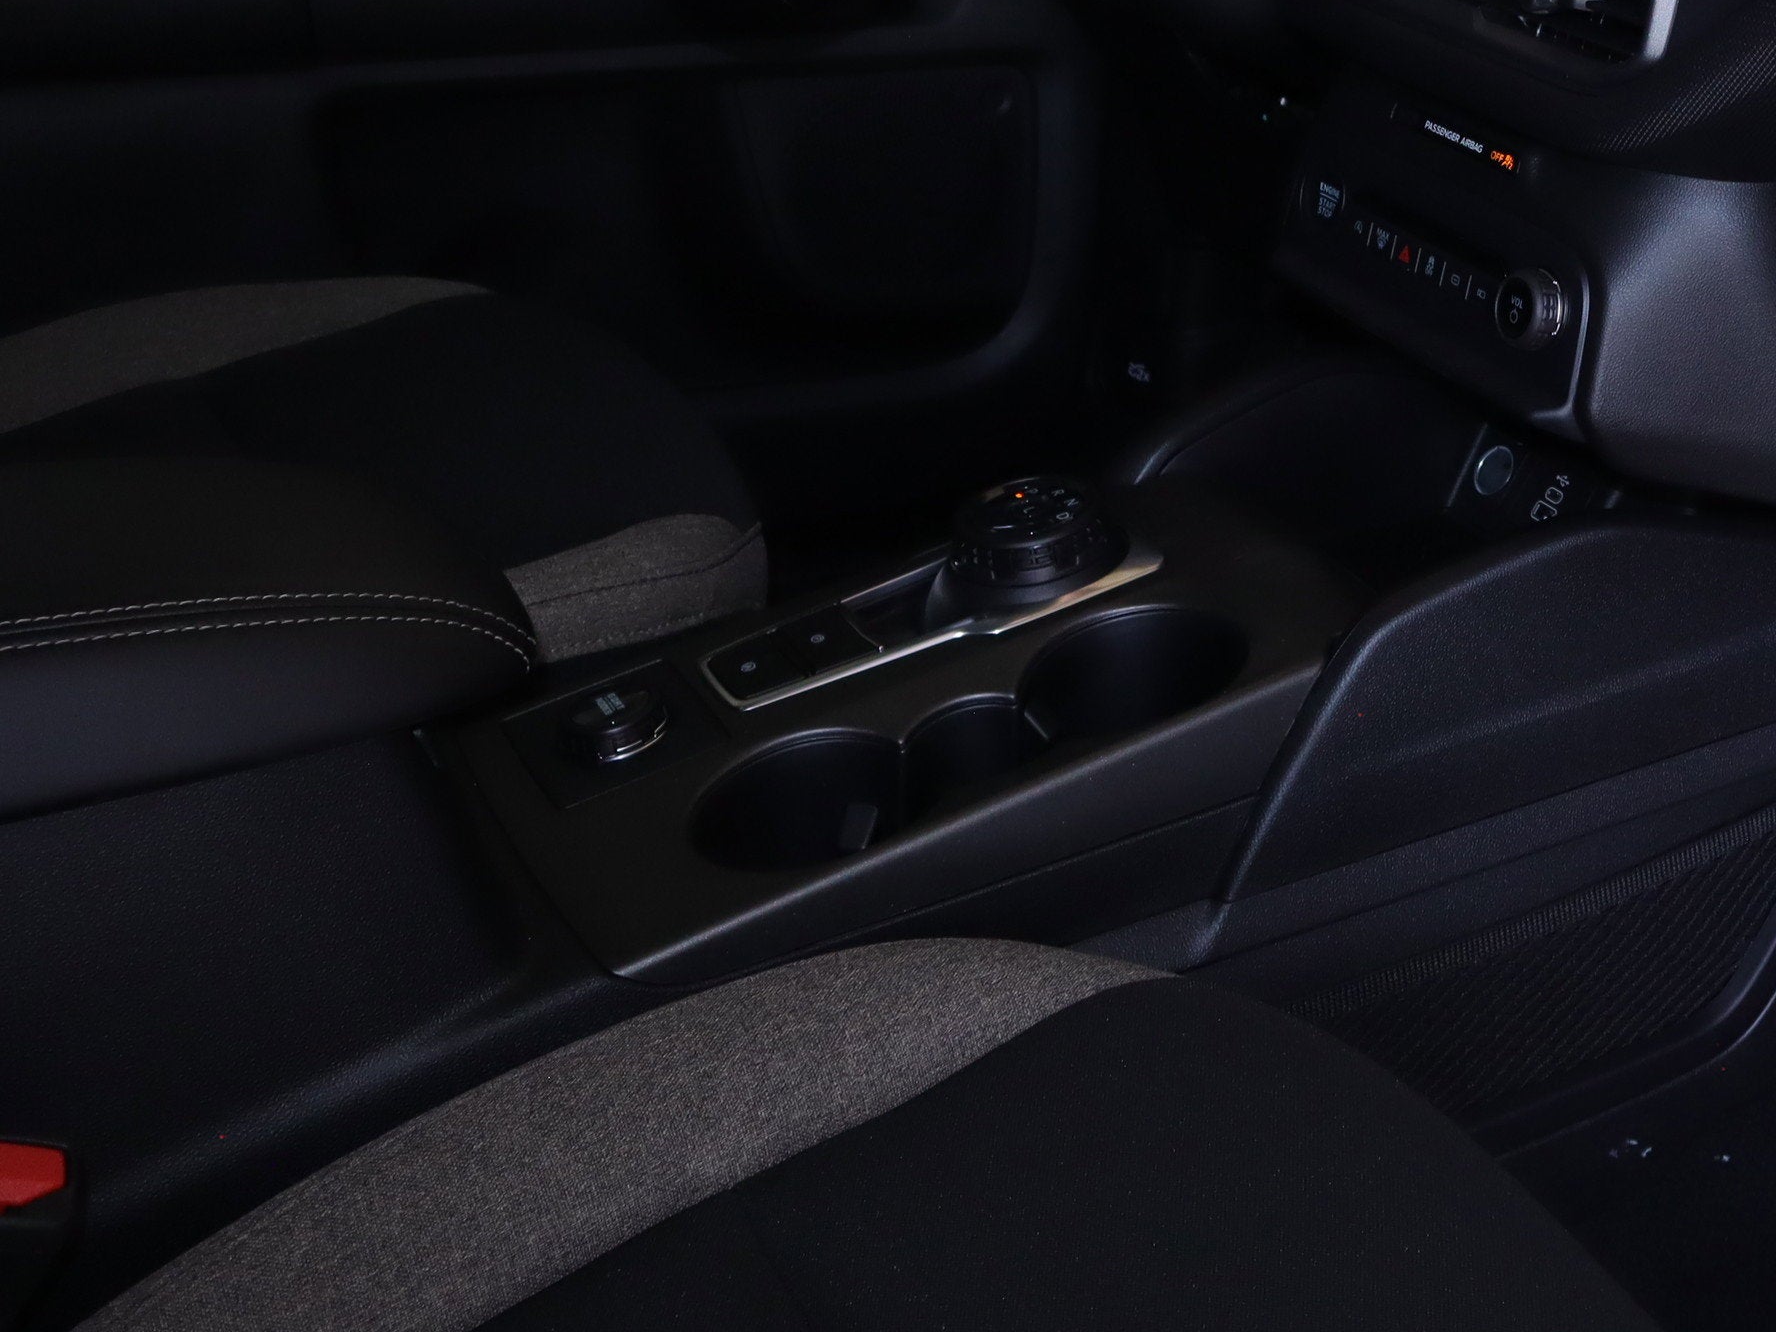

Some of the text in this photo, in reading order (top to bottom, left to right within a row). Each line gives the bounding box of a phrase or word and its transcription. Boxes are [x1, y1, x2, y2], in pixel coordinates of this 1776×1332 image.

[1424, 119, 1504, 163] PASSENGER AIRBAG OFF
[1317, 206, 1333, 219] STOP
